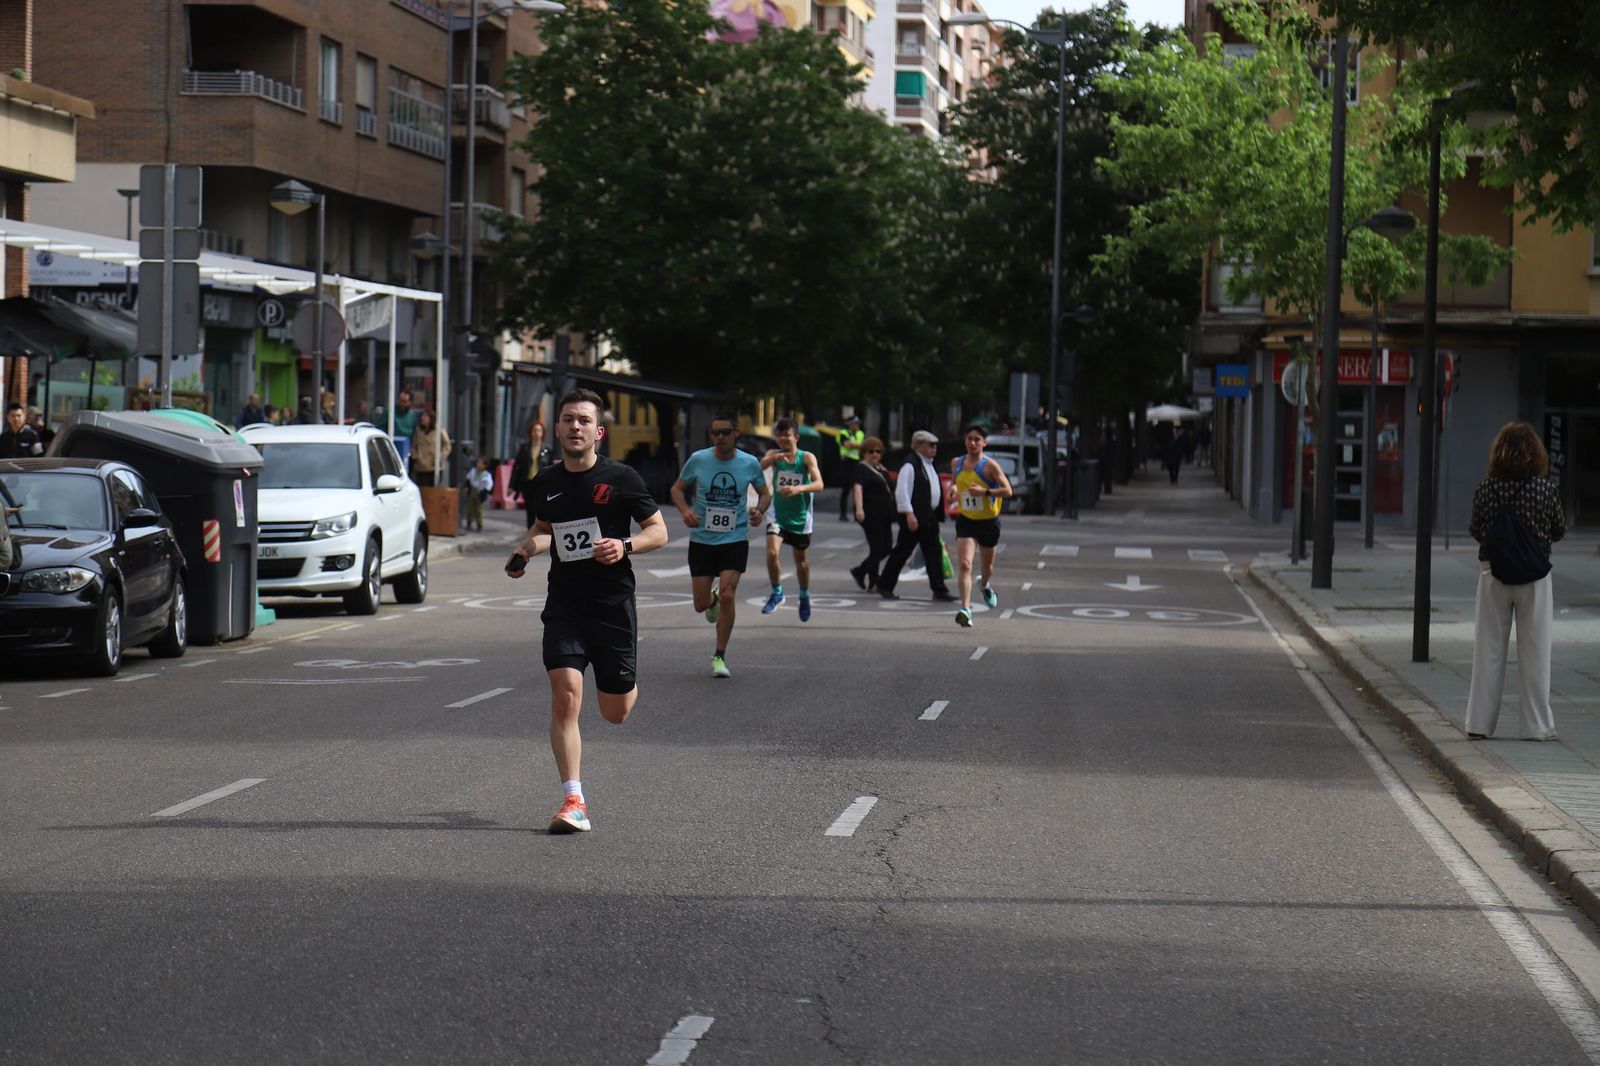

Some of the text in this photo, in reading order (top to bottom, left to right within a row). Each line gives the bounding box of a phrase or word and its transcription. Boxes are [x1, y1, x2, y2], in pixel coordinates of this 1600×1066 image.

[779, 476, 801, 486] 242
[966, 497, 976, 506] 11
[712, 514, 730, 527] 88
[563, 531, 593, 552] 32
